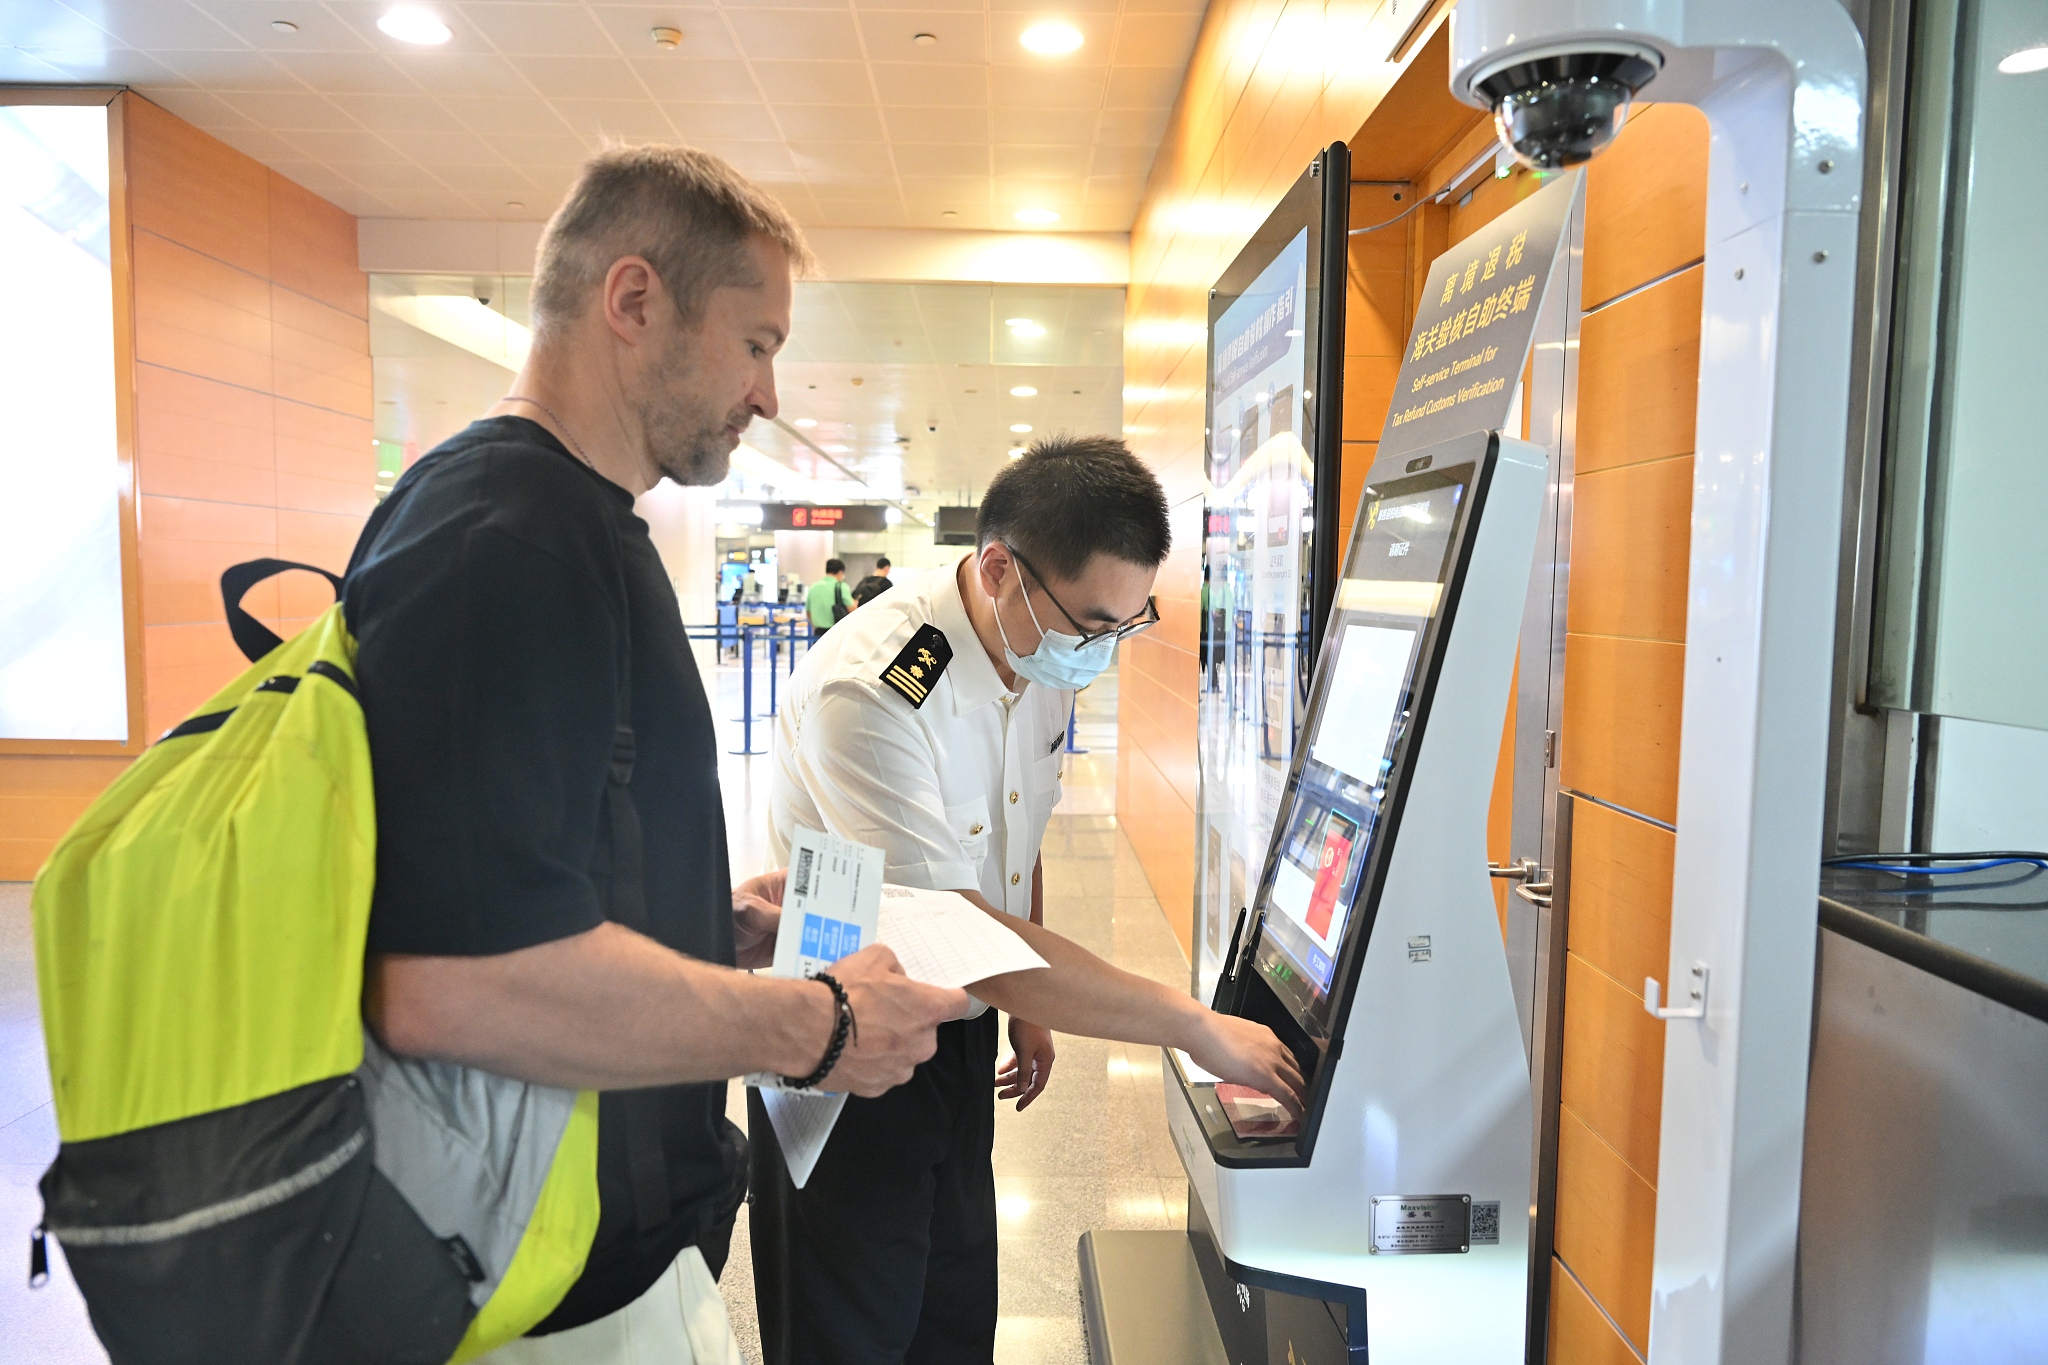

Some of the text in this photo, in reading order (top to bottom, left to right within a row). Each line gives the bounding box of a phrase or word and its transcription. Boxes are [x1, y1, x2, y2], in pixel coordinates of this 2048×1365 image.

[1440, 230, 1527, 307] 离境退税
[1410, 275, 1536, 363] 海关验核自助终端
[1392, 376, 1505, 427] Tax Refund Customs Verification
[1411, 346, 1498, 393] Self-service Terminal for
